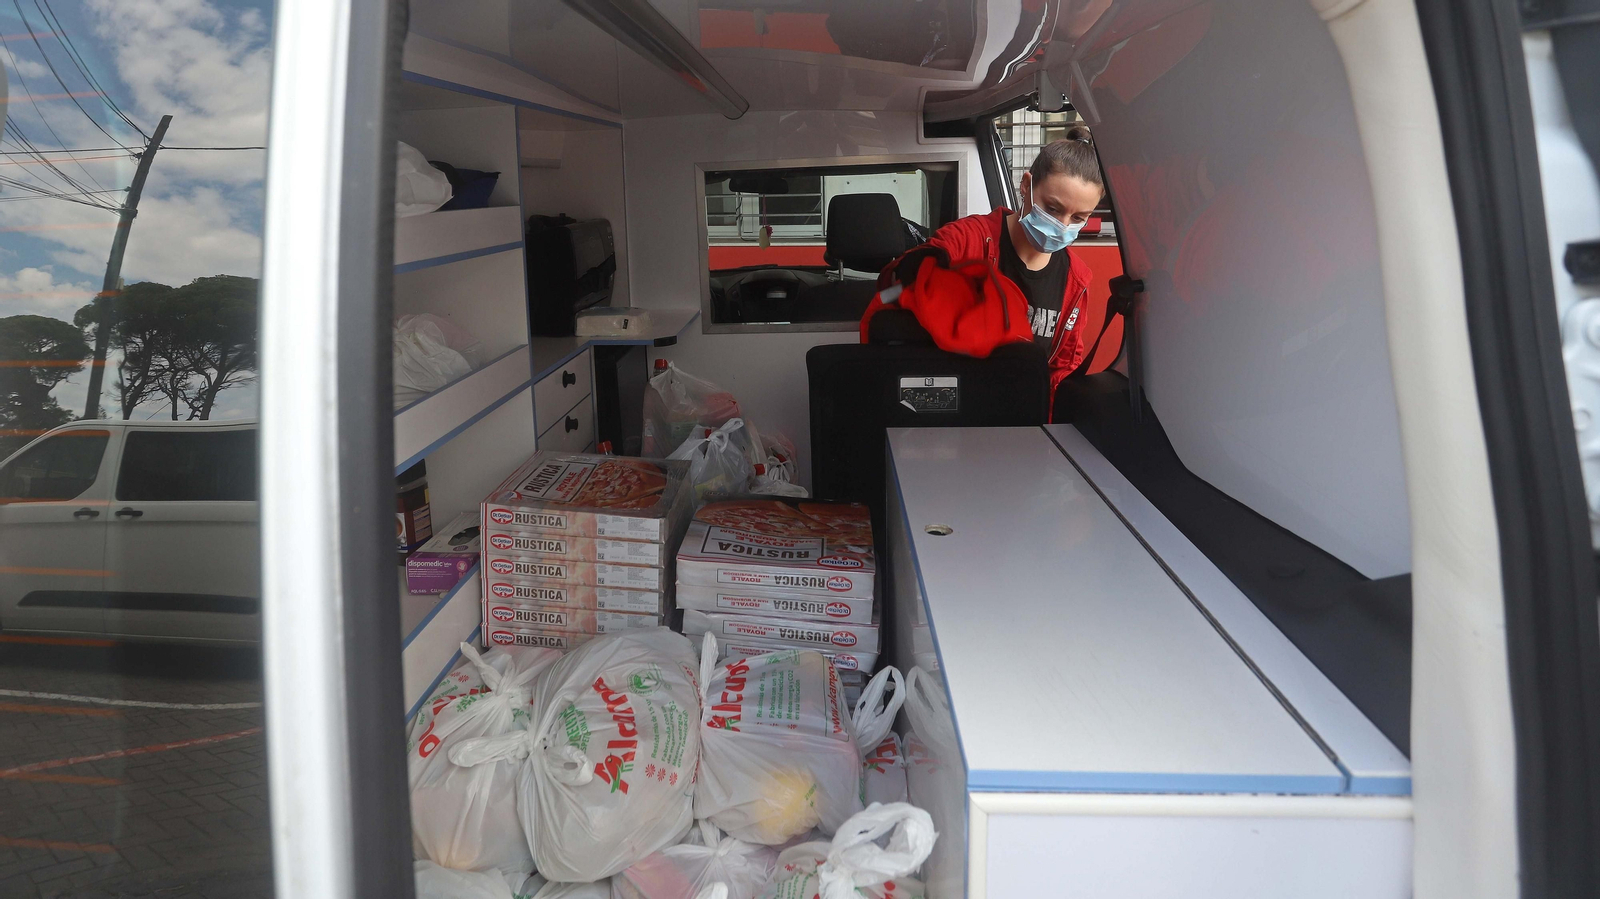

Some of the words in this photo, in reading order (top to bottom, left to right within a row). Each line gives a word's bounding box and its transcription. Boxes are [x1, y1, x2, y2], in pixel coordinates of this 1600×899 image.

[1028, 304, 1061, 338] NE
[524, 464, 562, 493] RUSTICA
[555, 472, 577, 492] ROYALE
[515, 513, 562, 527] RUSTICA
[719, 529, 777, 542] MUSHROOM
[735, 536, 795, 547] ROYALE
[515, 539, 562, 552] RUSTICA
[718, 542, 809, 558] RUSTICA
[515, 564, 562, 576] RUSTICA
[774, 575, 825, 588] RUSTICA
[516, 588, 562, 600] RUSTICA
[773, 600, 824, 613] RUSTICA
[516, 612, 563, 624] RUSTICA
[516, 636, 563, 647] RUSTICA
[779, 628, 830, 642] RUSTICA
[828, 661, 843, 734] www.alcampo
